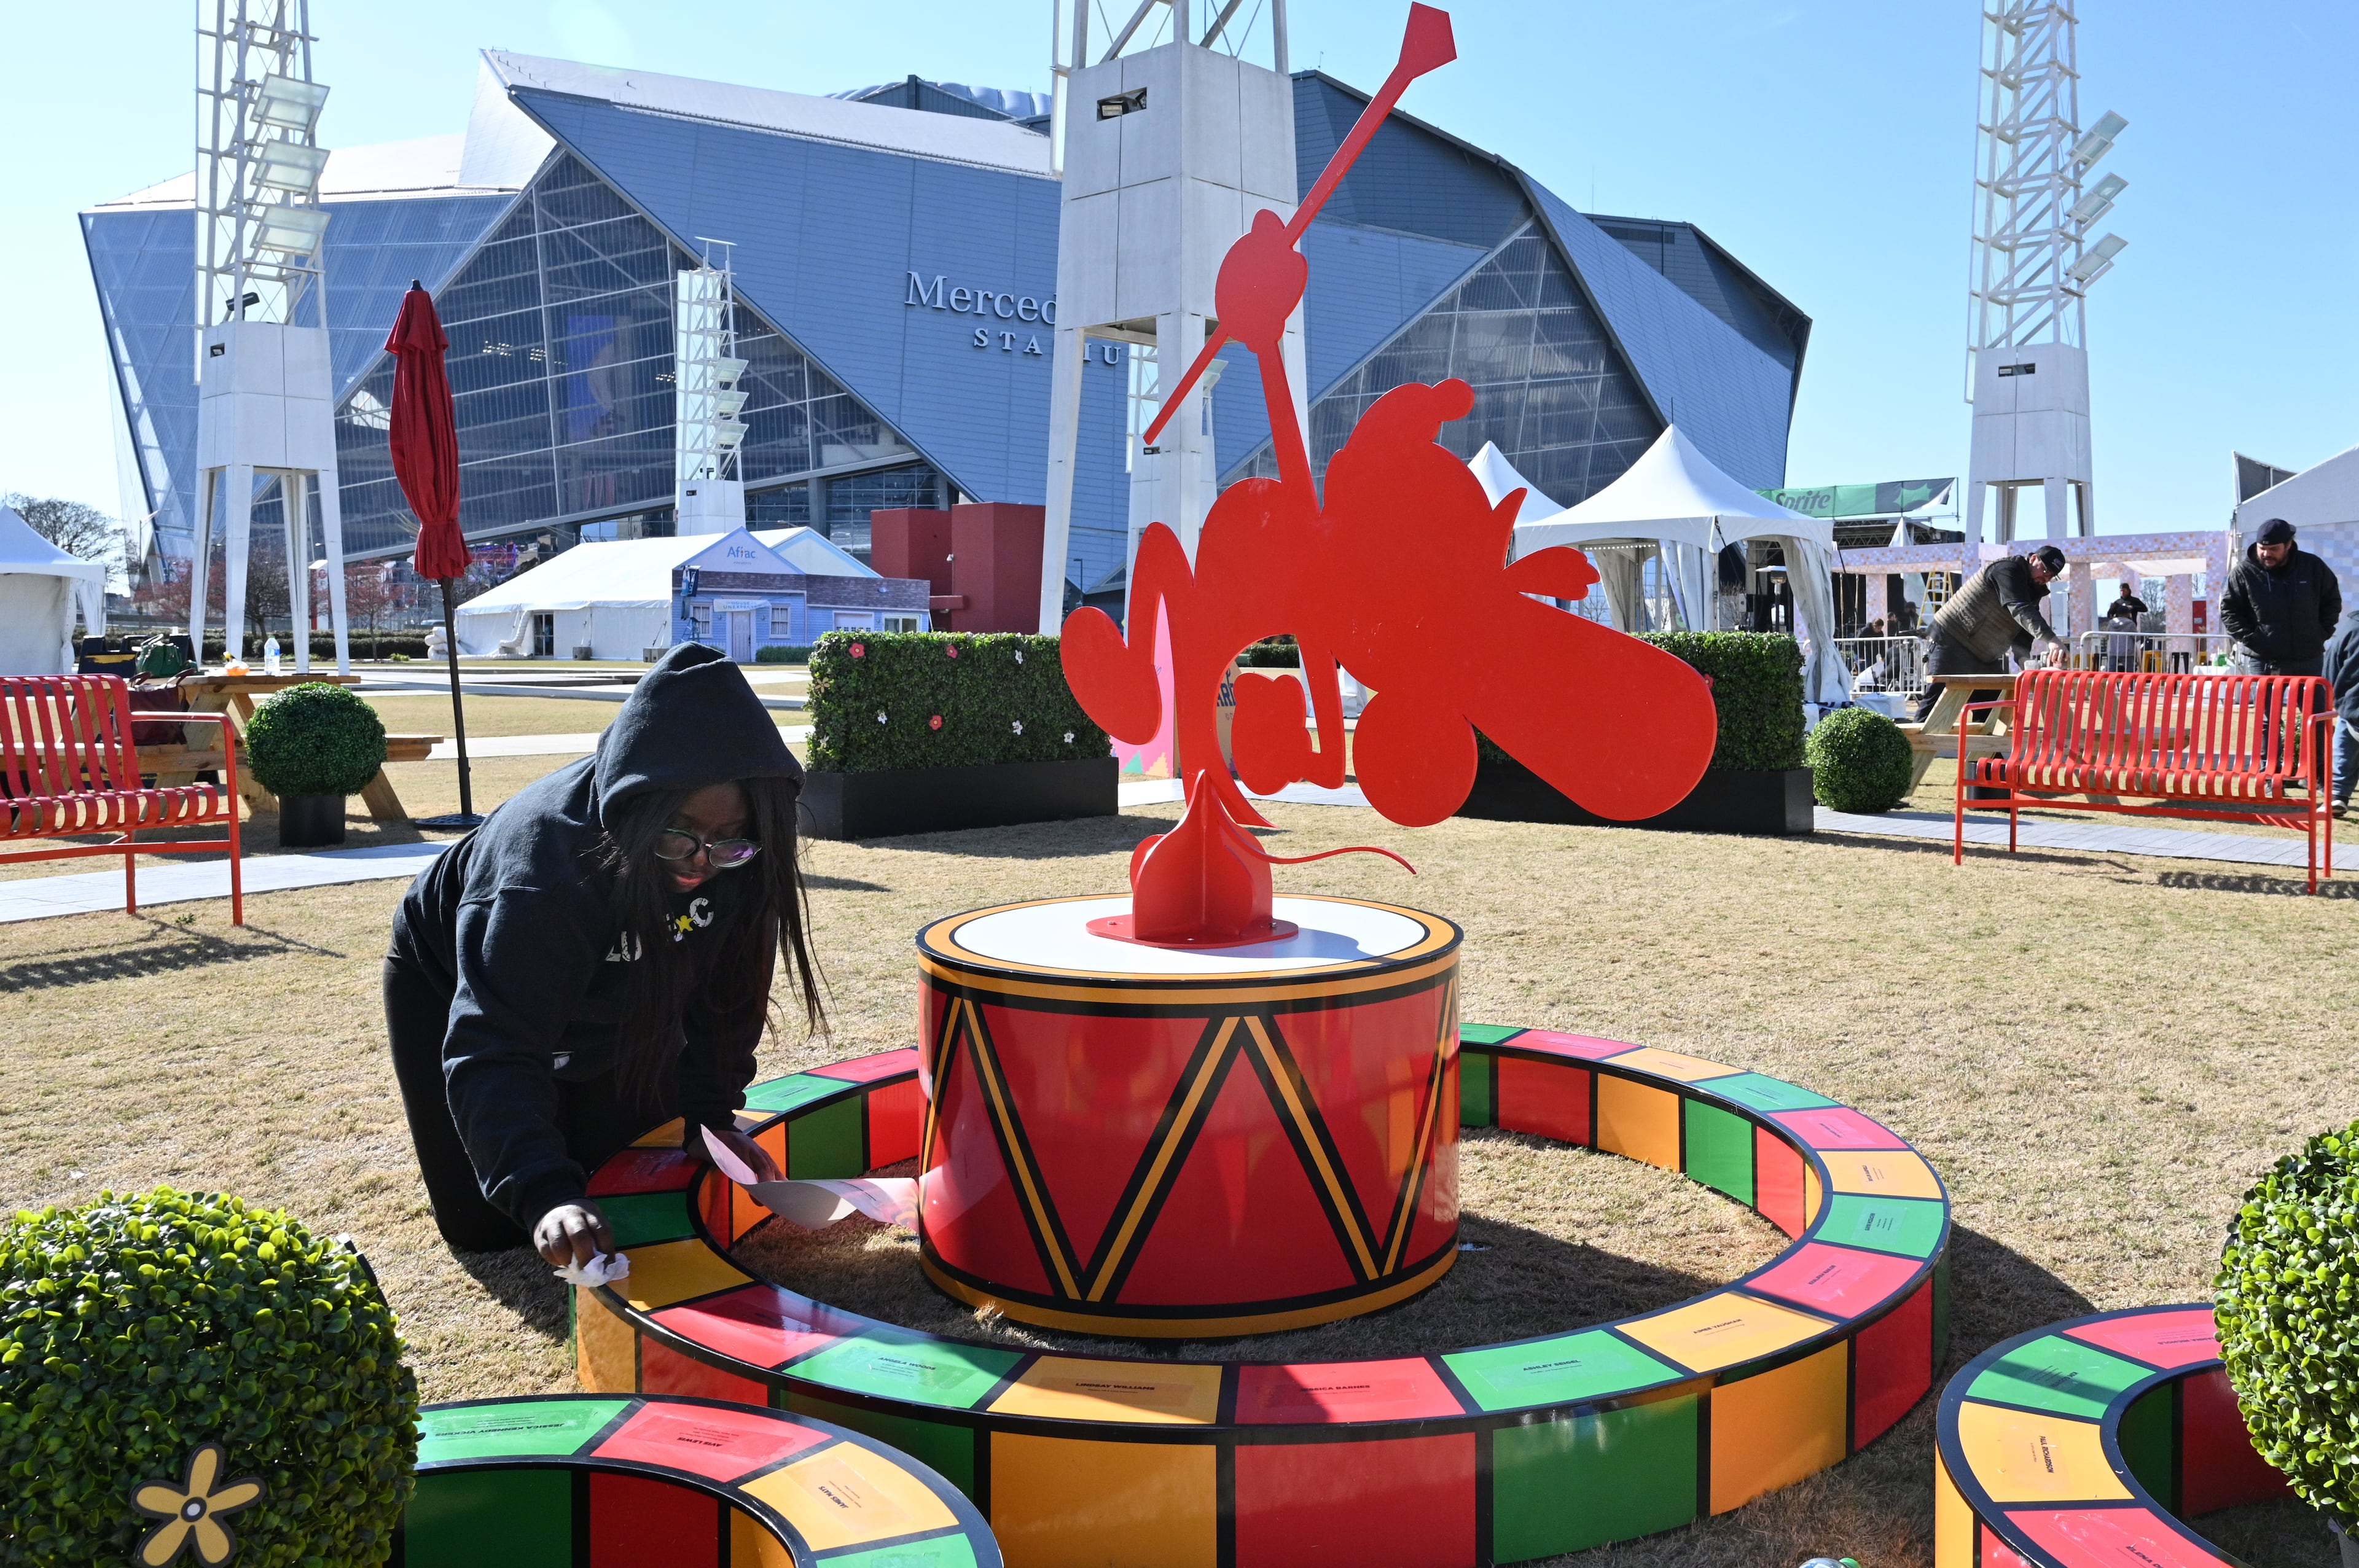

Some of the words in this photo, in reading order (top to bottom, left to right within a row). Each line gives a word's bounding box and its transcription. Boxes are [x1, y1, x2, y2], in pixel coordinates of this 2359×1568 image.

[973, 327, 1122, 365] STAIU
[1776, 491, 1831, 510] Sprite
[727, 546, 756, 559] Aflac
[2039, 1435, 2048, 1446] PAUL
[2041, 1446, 2054, 1473] RICHARDSON
[831, 1496, 849, 1508] JAMES
